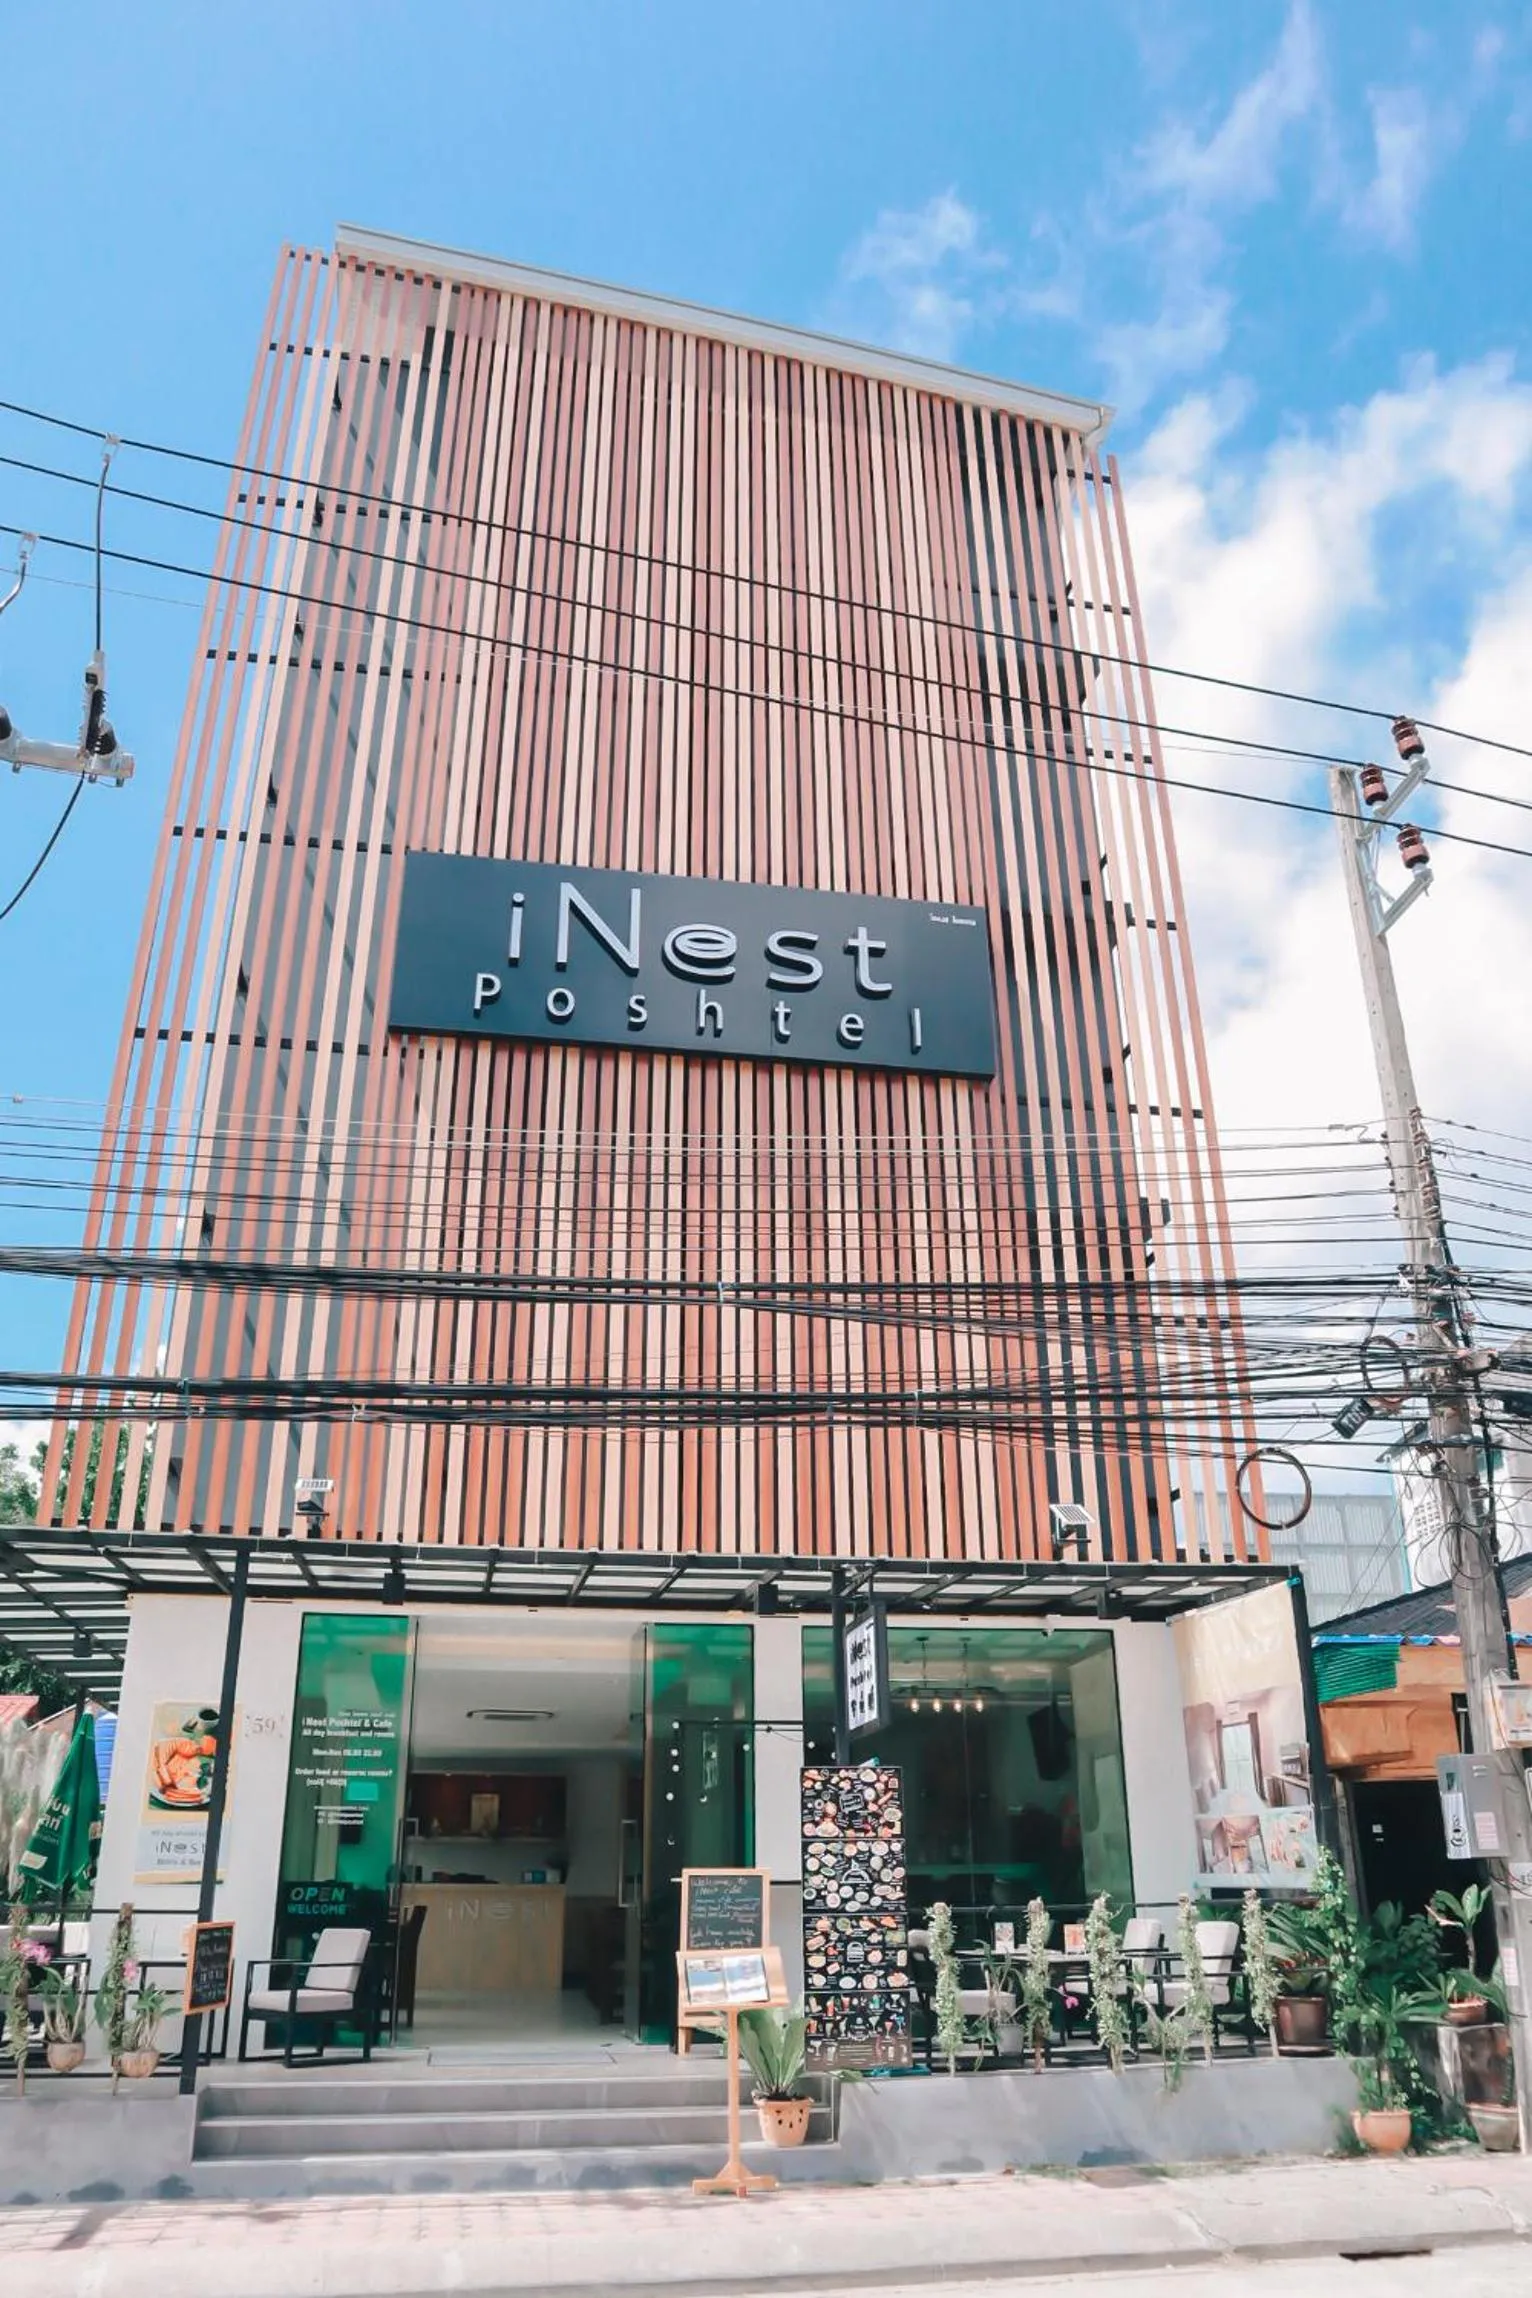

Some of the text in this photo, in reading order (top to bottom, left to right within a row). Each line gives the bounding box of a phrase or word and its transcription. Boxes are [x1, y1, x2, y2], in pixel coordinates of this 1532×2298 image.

[508, 881, 893, 998] iNest
[473, 972, 922, 1054] Poshtel
[252, 1717, 275, 1735] 59
[290, 1887, 346, 1902] OPEN
[287, 1903, 346, 1915] WELCOME
